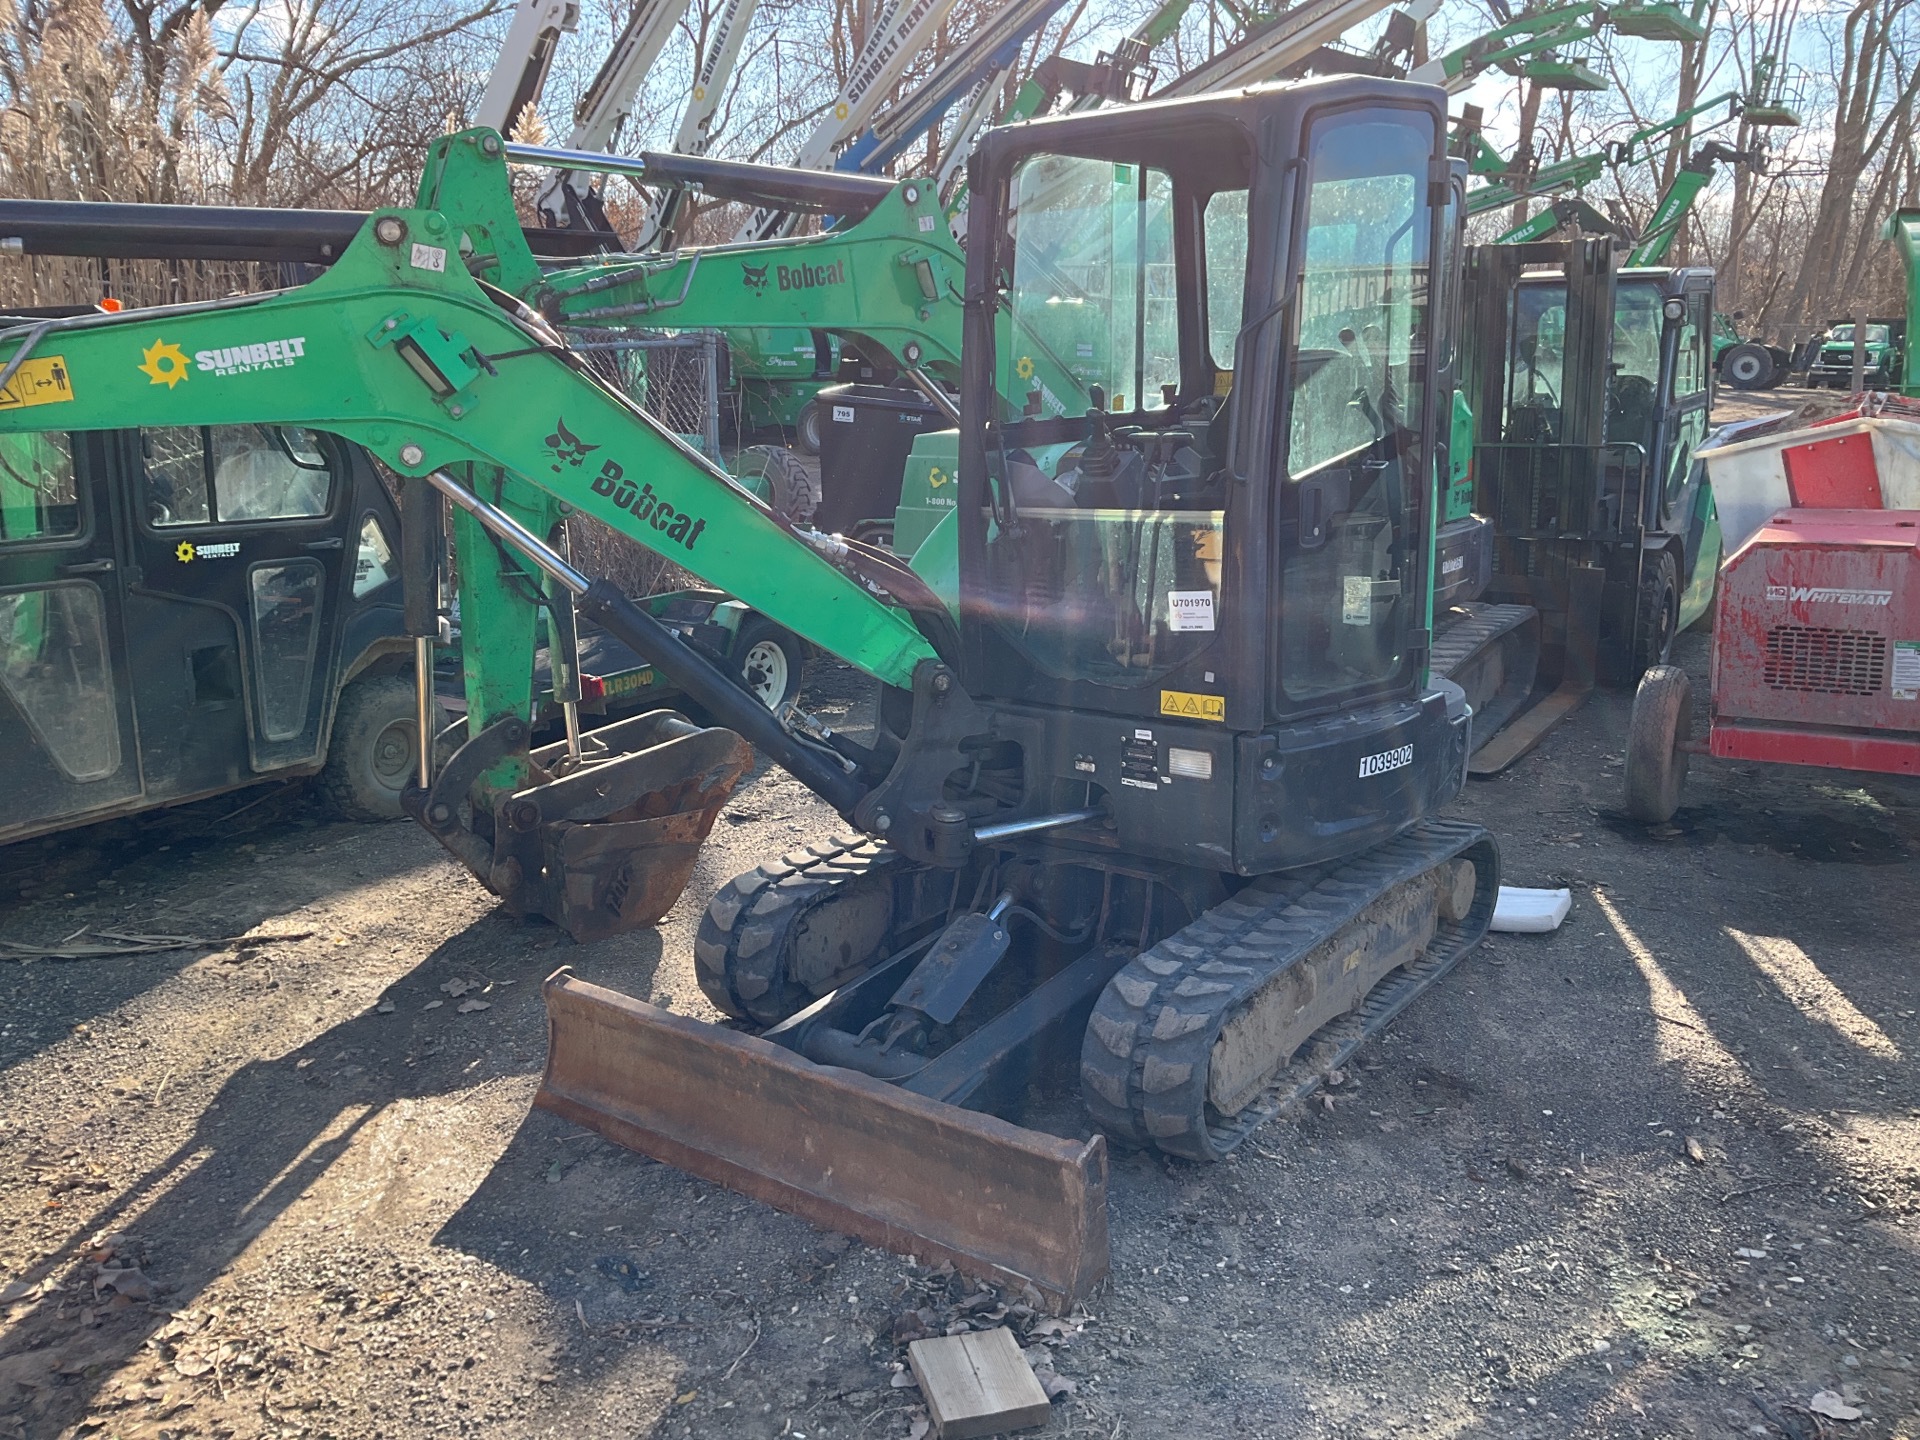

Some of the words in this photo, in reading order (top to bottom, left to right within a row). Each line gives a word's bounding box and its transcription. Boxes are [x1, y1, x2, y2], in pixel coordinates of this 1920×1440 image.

[701, 21, 729, 85] SUNBELT
[848, 35, 899, 104] SUNBELT
[776, 259, 846, 291] Bobcat
[195, 337, 305, 371] SUNBELT
[215, 358, 295, 377] RENTALS
[590, 459, 707, 550] Bobcat
[925, 497, 945, 505] 1-800
[195, 542, 241, 556] SUNBELT
[1172, 598, 1211, 608] U701970
[1790, 586, 1893, 605] WHITEMAN
[1361, 745, 1412, 776] 1039902
